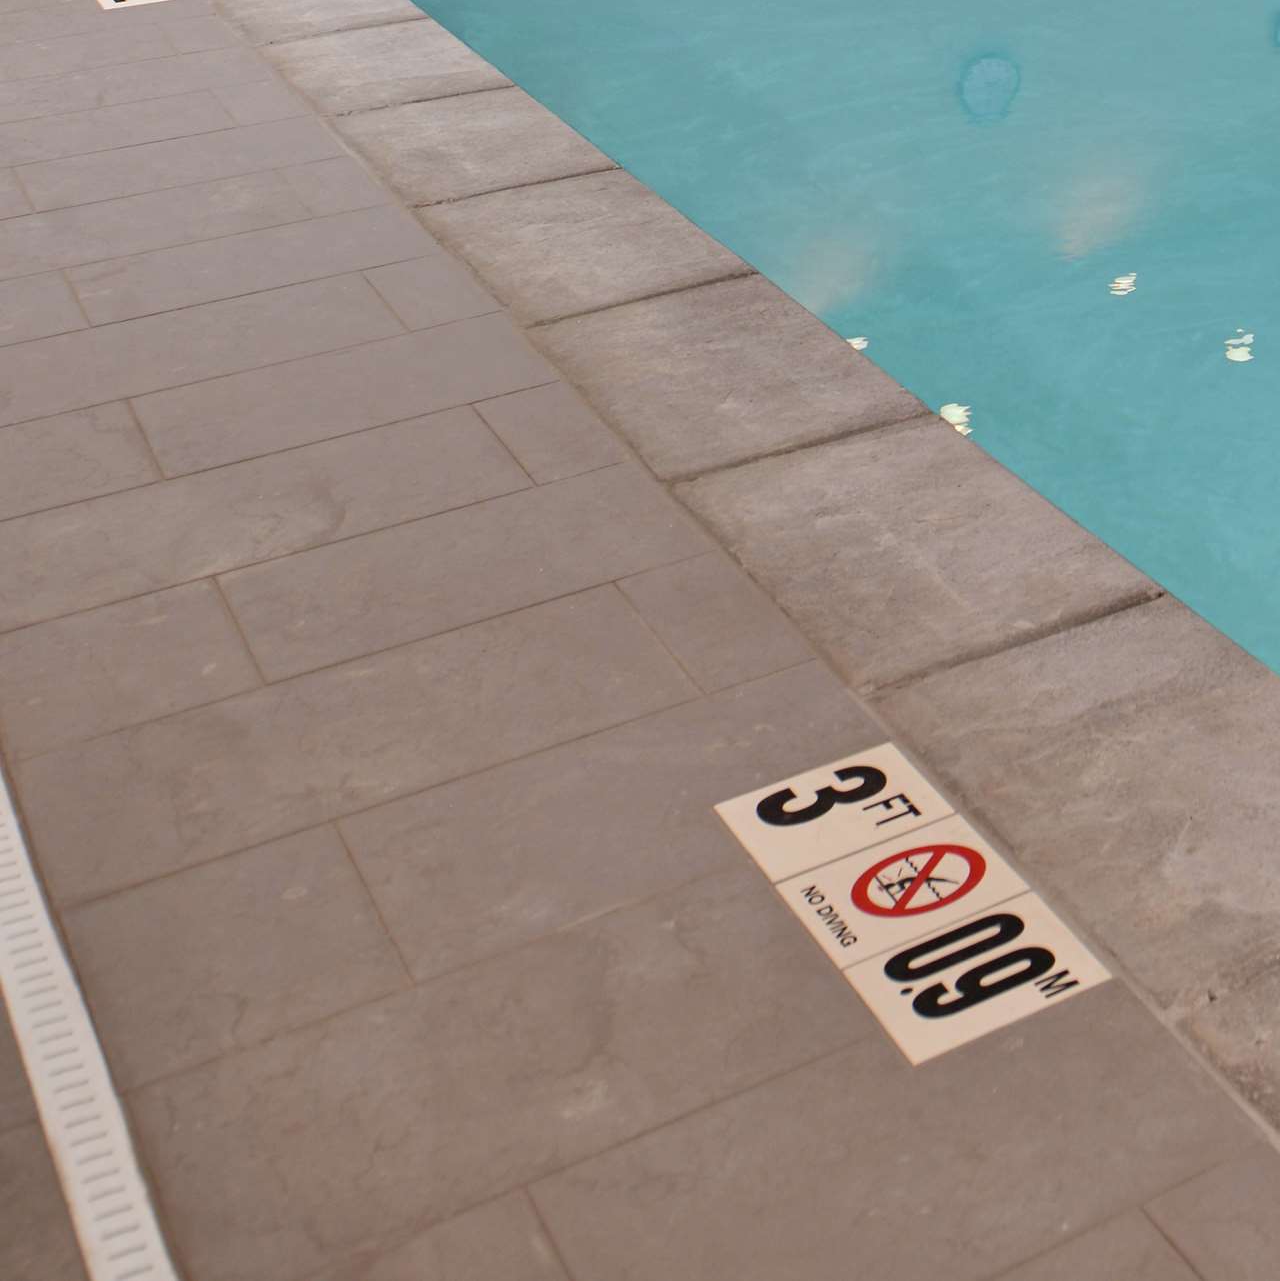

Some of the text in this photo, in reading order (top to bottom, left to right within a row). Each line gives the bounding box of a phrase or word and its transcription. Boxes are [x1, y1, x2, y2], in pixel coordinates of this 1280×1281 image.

[756, 765, 922, 827] 3 FT
[801, 885, 858, 949] NO DIVING
[884, 913, 1080, 1018] 0.9 M
